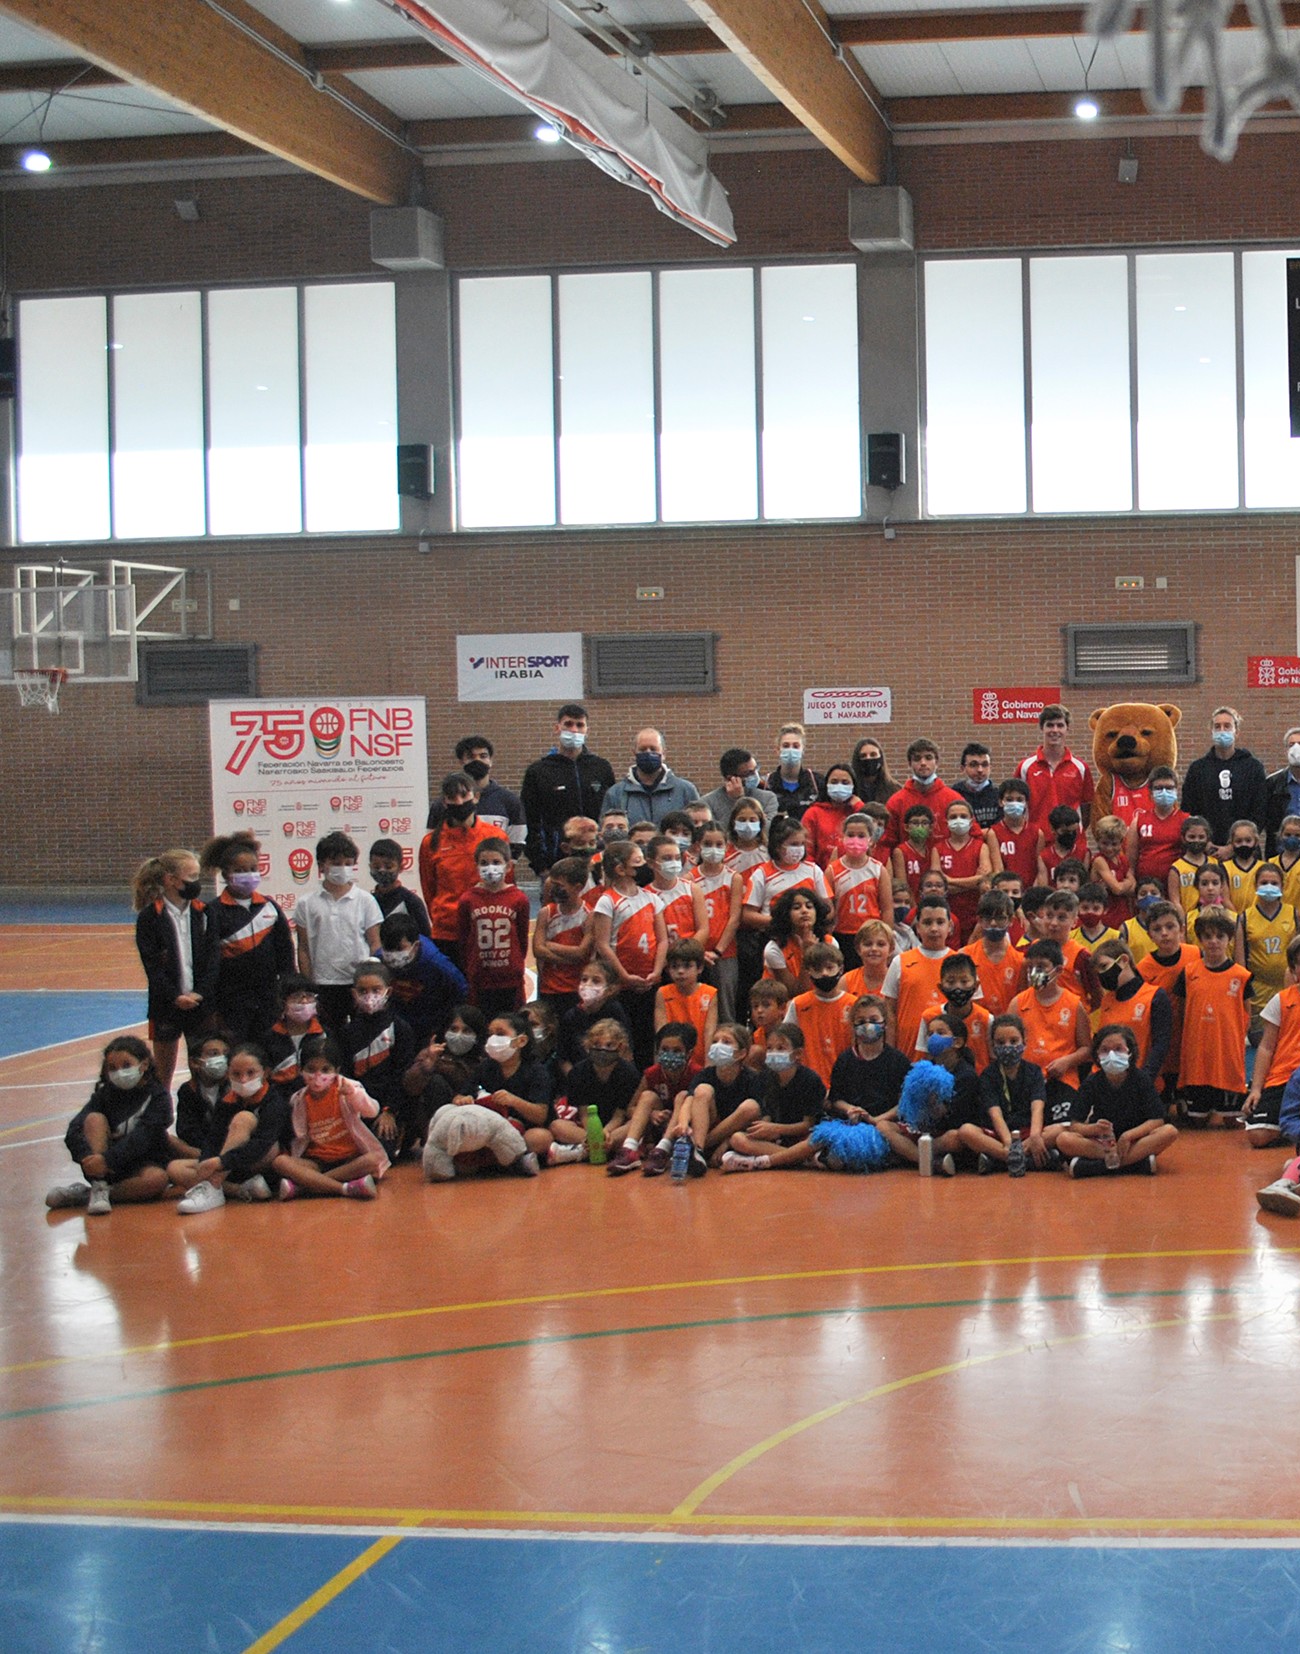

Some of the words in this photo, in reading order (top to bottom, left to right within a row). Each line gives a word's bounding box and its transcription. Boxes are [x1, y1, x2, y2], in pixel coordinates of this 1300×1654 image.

[486, 655, 570, 669] INTERSPORT
[495, 670, 544, 679] IRABIA
[807, 701, 836, 709] JUEGOS
[841, 700, 888, 709] DEPORTIVOS
[1001, 700, 1044, 709] Gobierno
[350, 708, 413, 731] FNB
[823, 711, 833, 719] DE
[838, 710, 872, 719] NAVARRA
[1001, 711, 1014, 719] de
[225, 710, 304, 775] 75
[351, 733, 413, 757] NSF
[307, 759, 340, 767] Navarra
[1000, 841, 1015, 855] 40
[848, 893, 868, 914] 12
[477, 917, 511, 950] 62
[637, 932, 649, 954] 4
[1264, 937, 1281, 954] 12
[479, 950, 498, 959] CITY
[500, 949, 511, 958] OF
